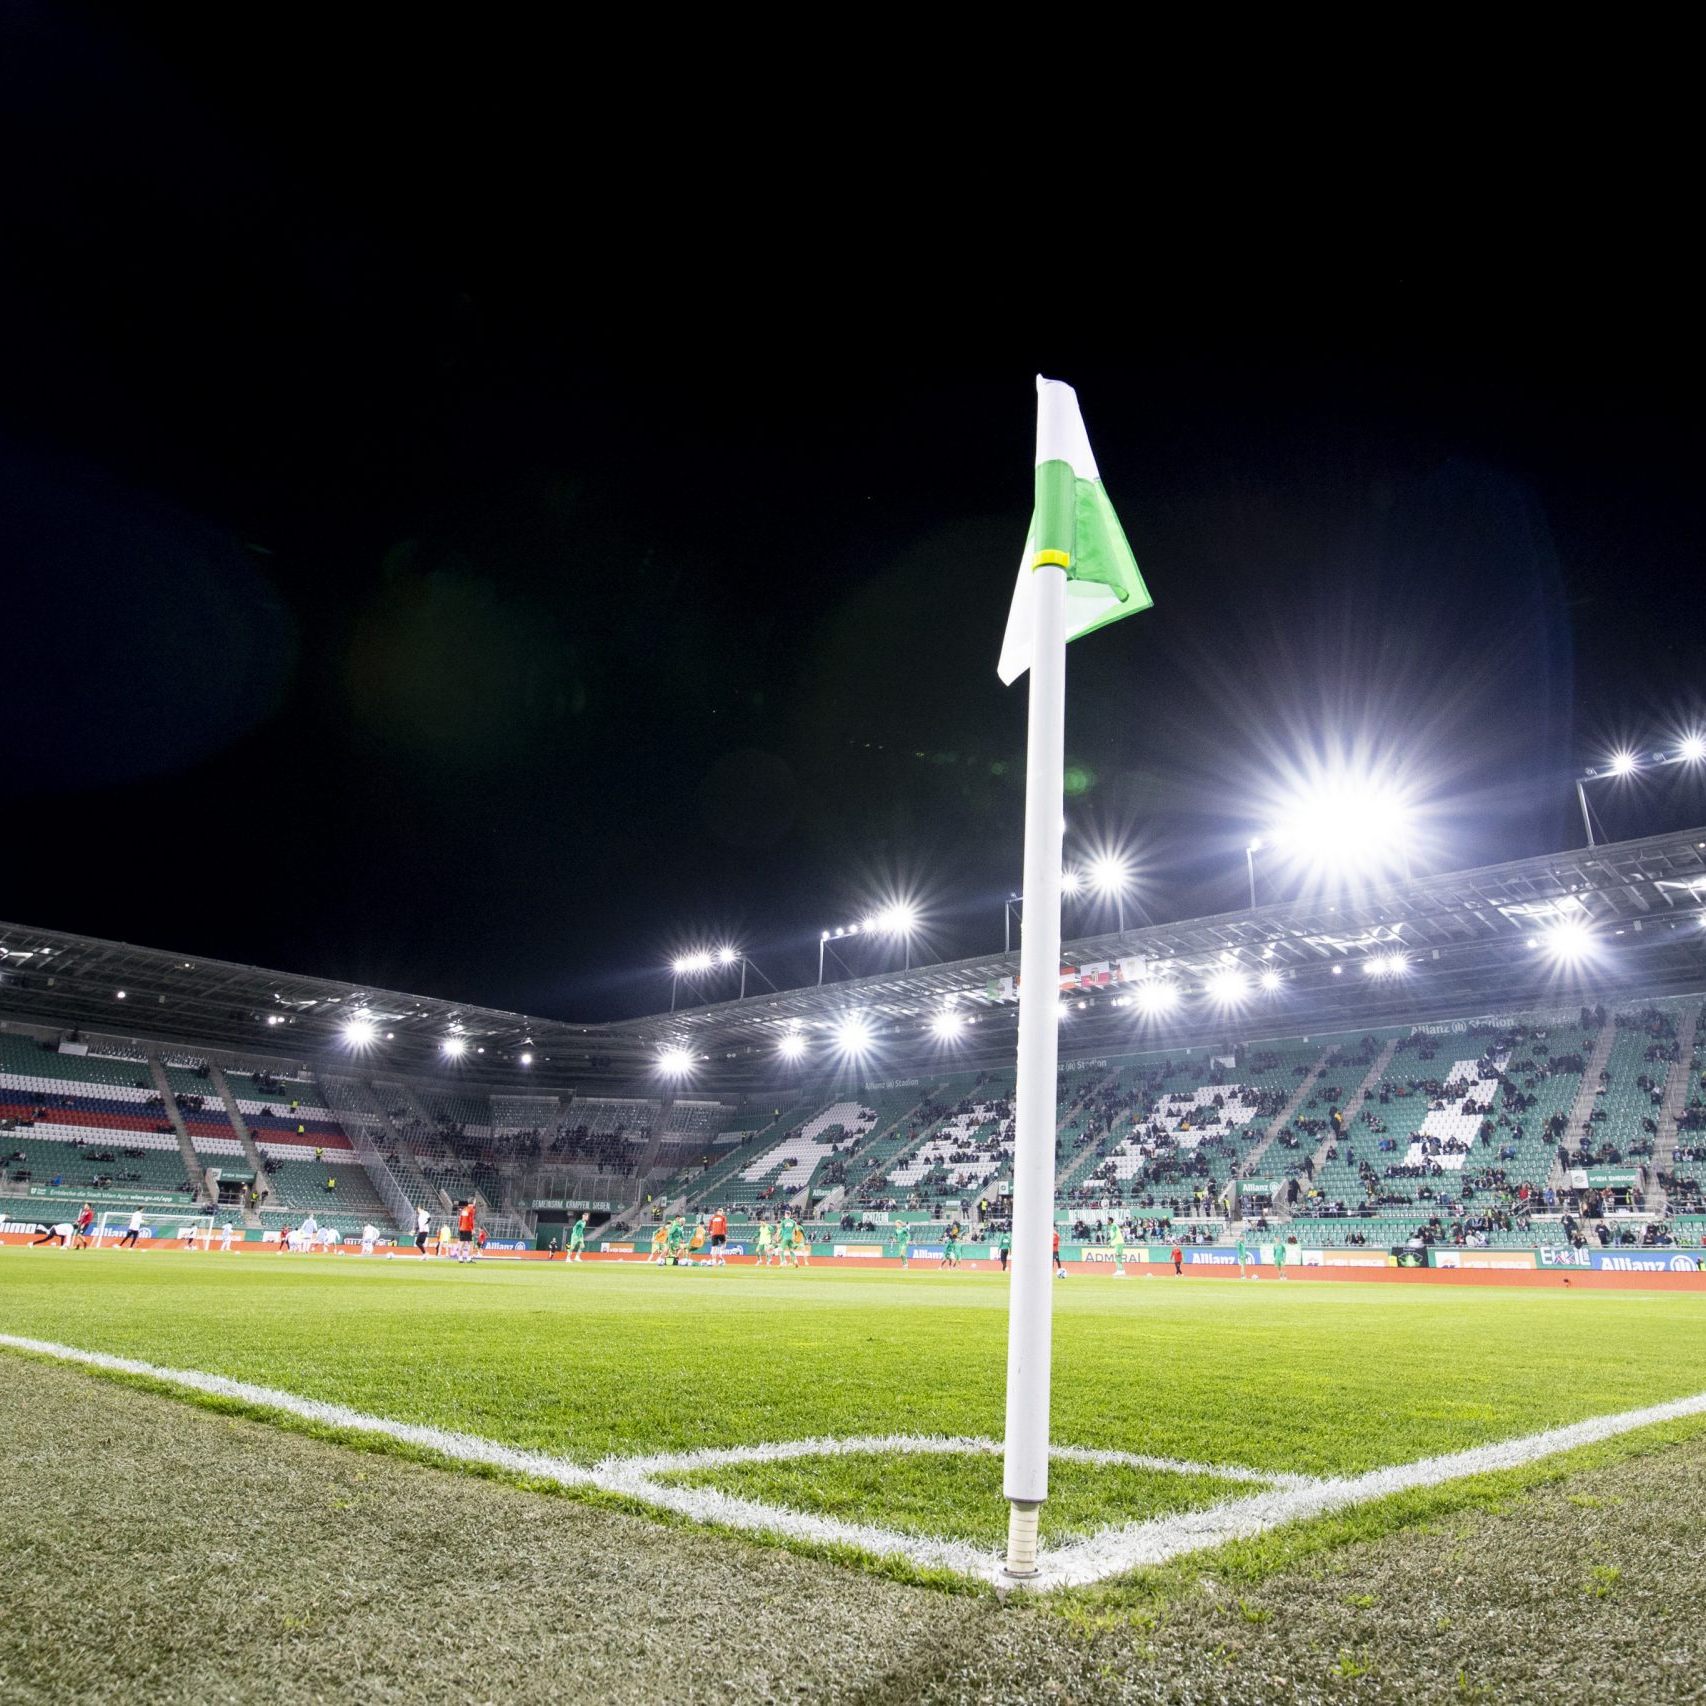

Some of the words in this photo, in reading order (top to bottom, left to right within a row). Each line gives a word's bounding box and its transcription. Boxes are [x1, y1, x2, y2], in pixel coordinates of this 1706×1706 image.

[895, 1079, 919, 1088] Stadion
[1242, 1183, 1268, 1192] Allianz
[531, 1199, 563, 1209] GEMEINSAM
[0, 1223, 37, 1233] UMA
[485, 1241, 514, 1250] Allianz
[1085, 1251, 1141, 1263] ADMRAL
[1192, 1253, 1236, 1265] Allianz
[1600, 1257, 1666, 1271] Allianz
